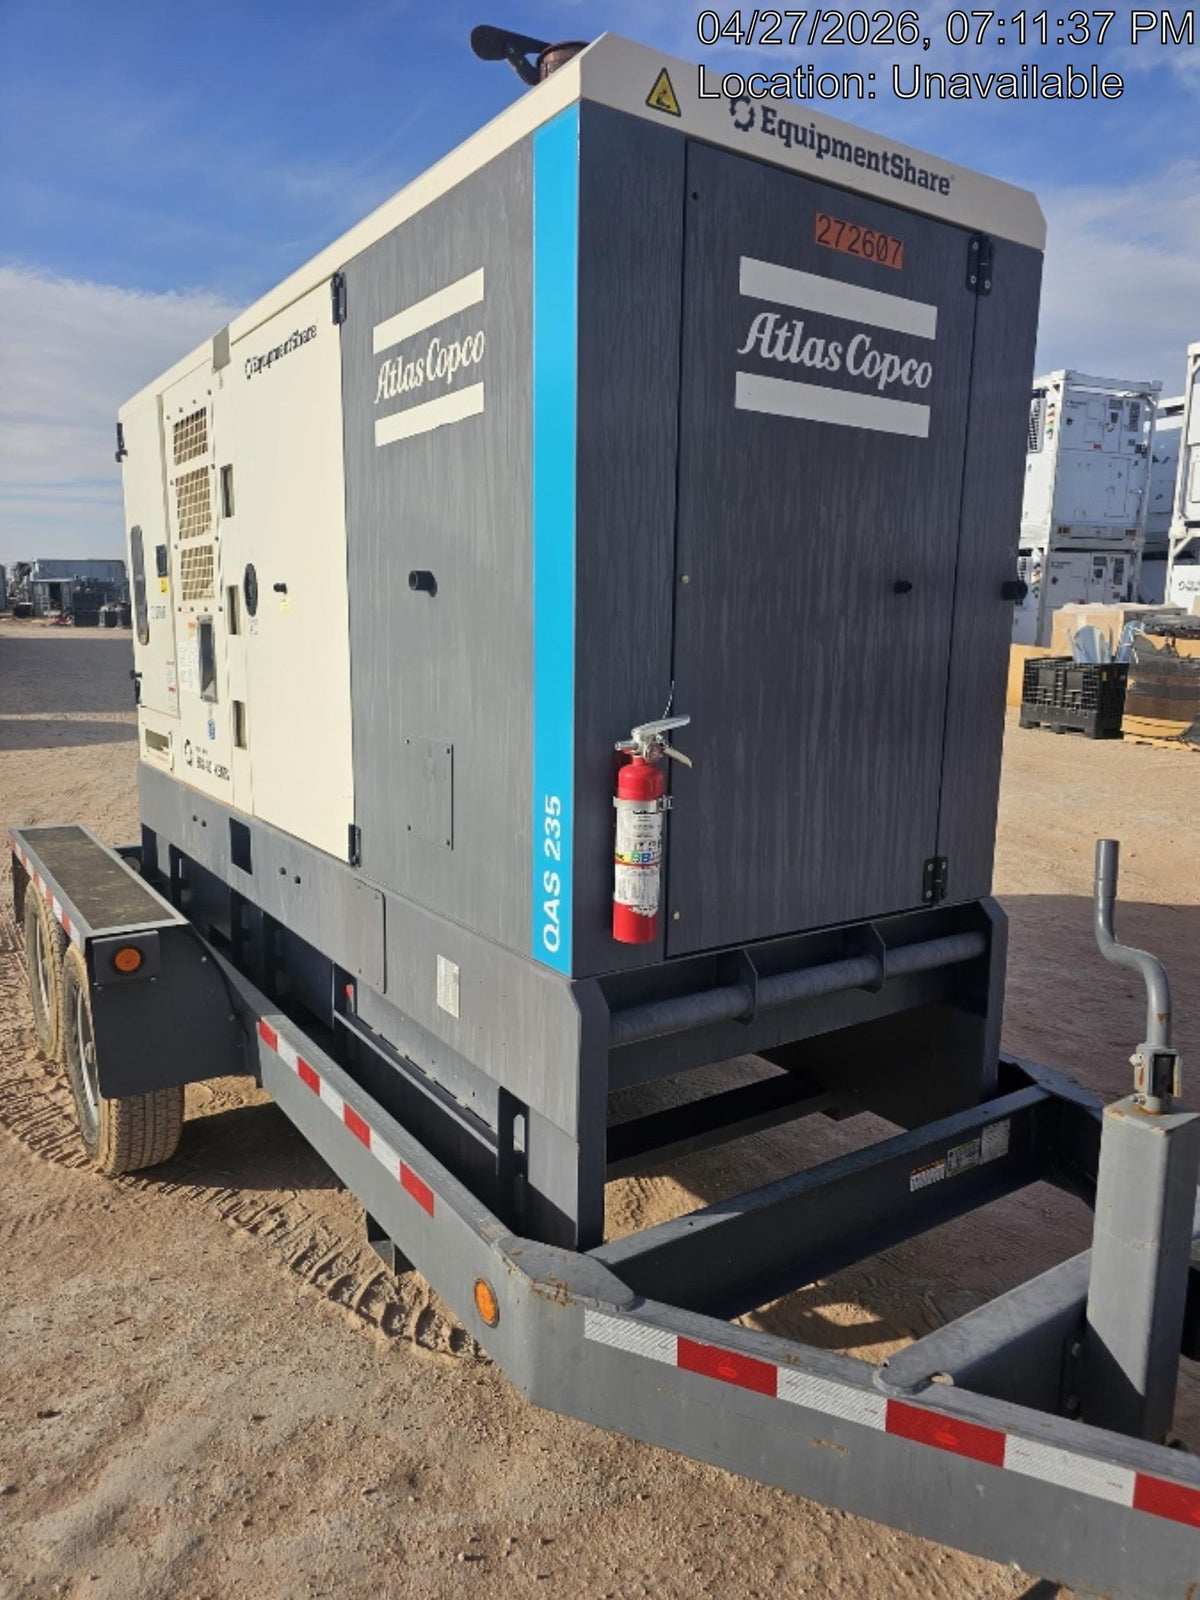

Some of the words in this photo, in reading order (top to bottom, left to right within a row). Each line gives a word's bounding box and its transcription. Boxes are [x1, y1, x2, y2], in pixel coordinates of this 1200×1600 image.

[760, 105, 951, 196] EquipmentShare
[817, 214, 902, 266] 272607
[374, 355, 424, 404] Atlas
[426, 330, 484, 384] Copco
[737, 312, 843, 372] Atlas
[846, 333, 933, 390] Copco
[543, 794, 562, 862] 235
[543, 870, 562, 953] QAS
